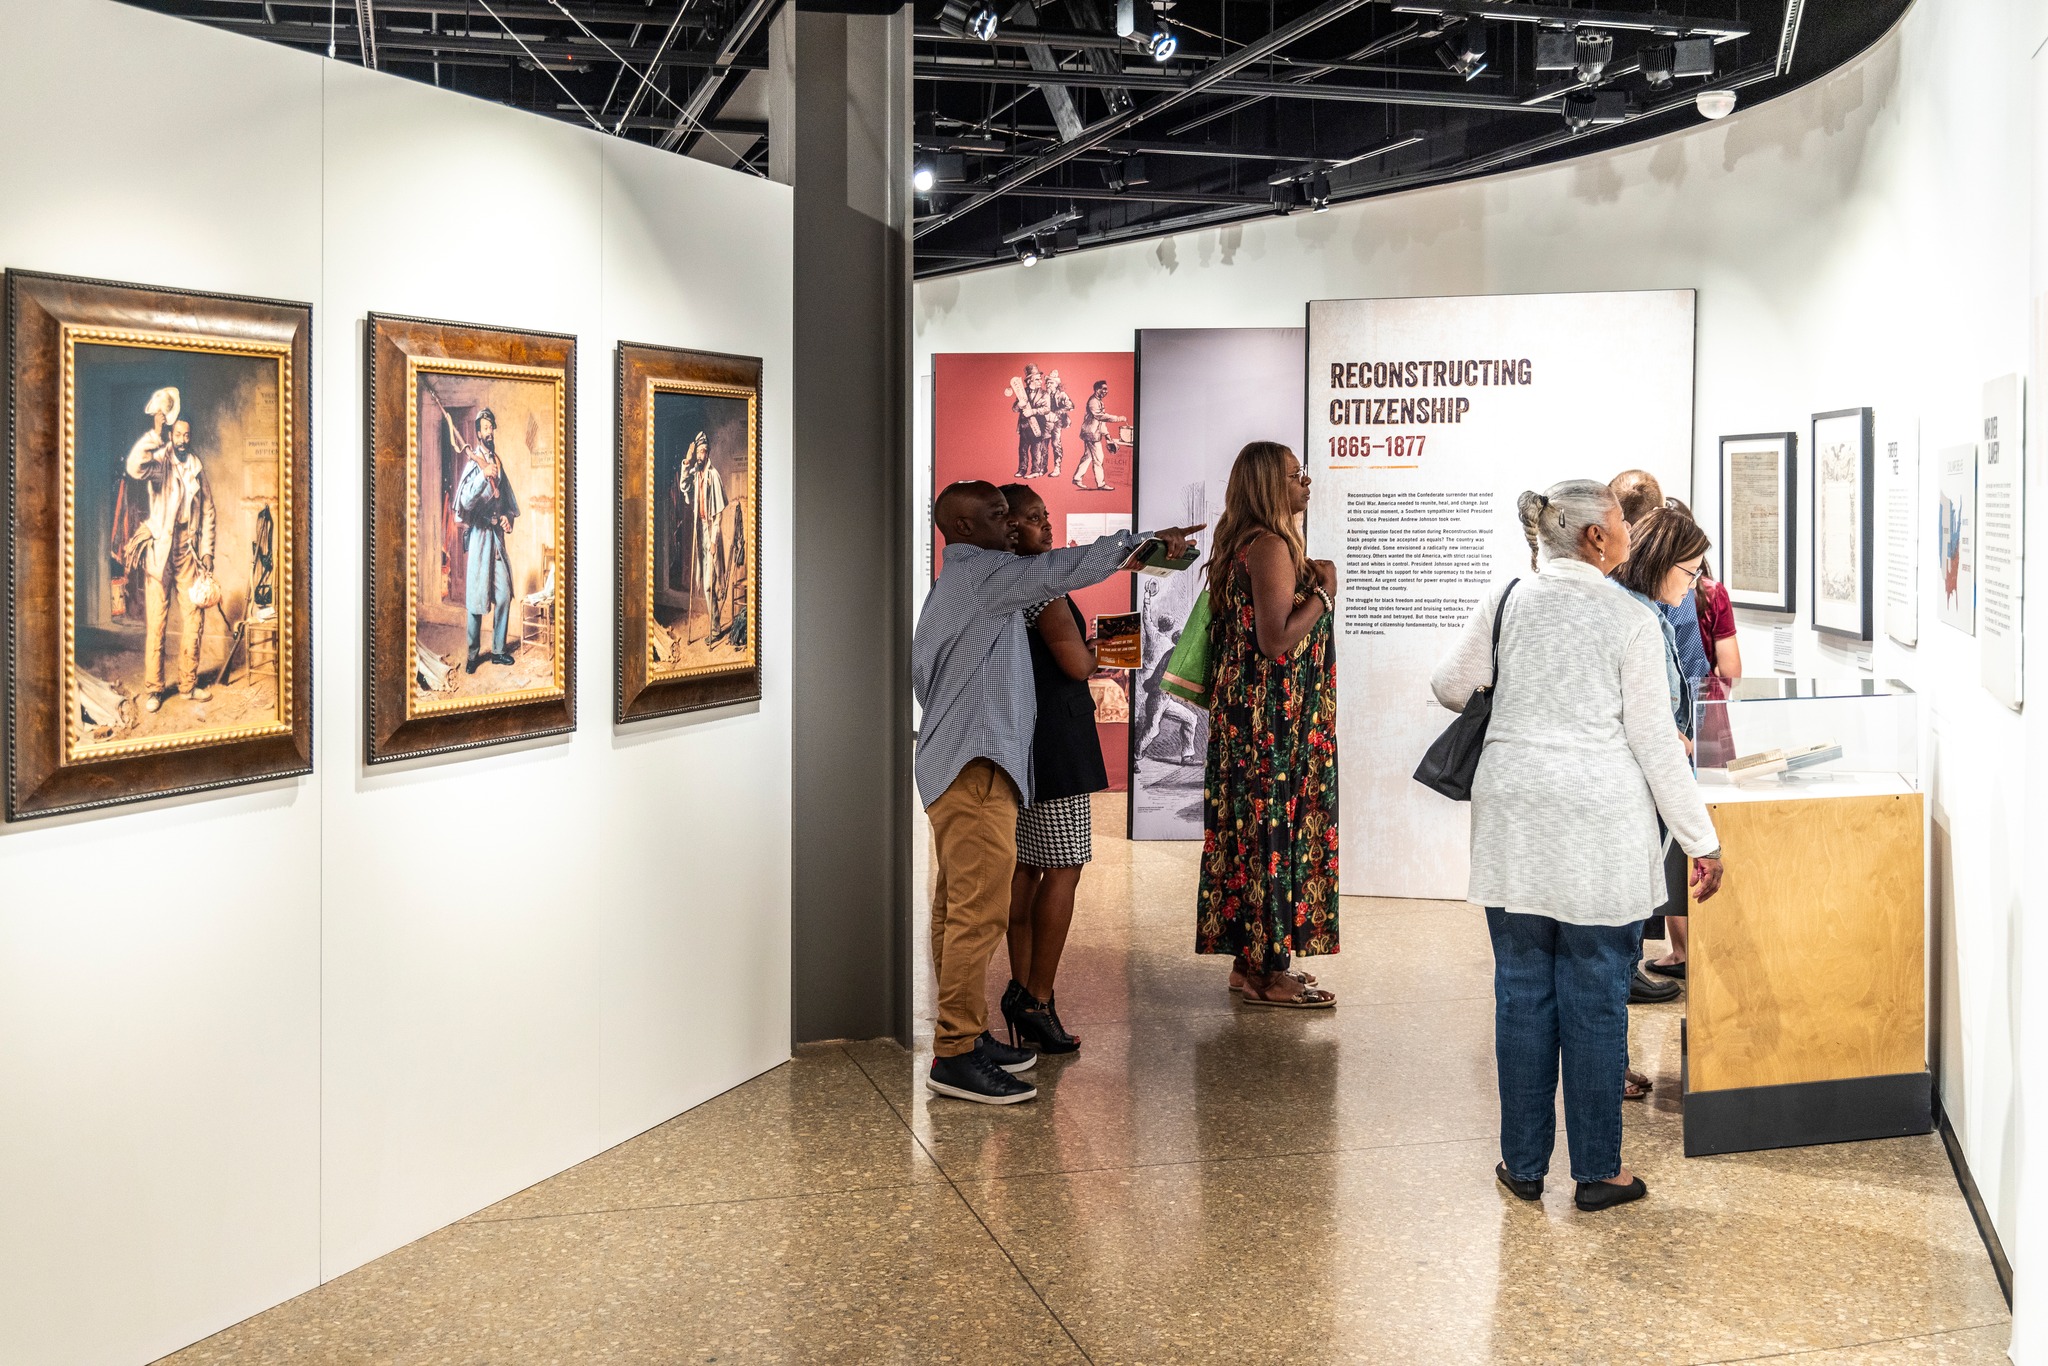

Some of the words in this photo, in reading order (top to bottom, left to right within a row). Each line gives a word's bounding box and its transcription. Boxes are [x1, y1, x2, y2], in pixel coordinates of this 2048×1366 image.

[1330, 358, 1532, 389] RECONSTRUCTING
[1329, 397, 1470, 426] CITIZENSHIP
[1328, 435, 1426, 458] 1865–1877
